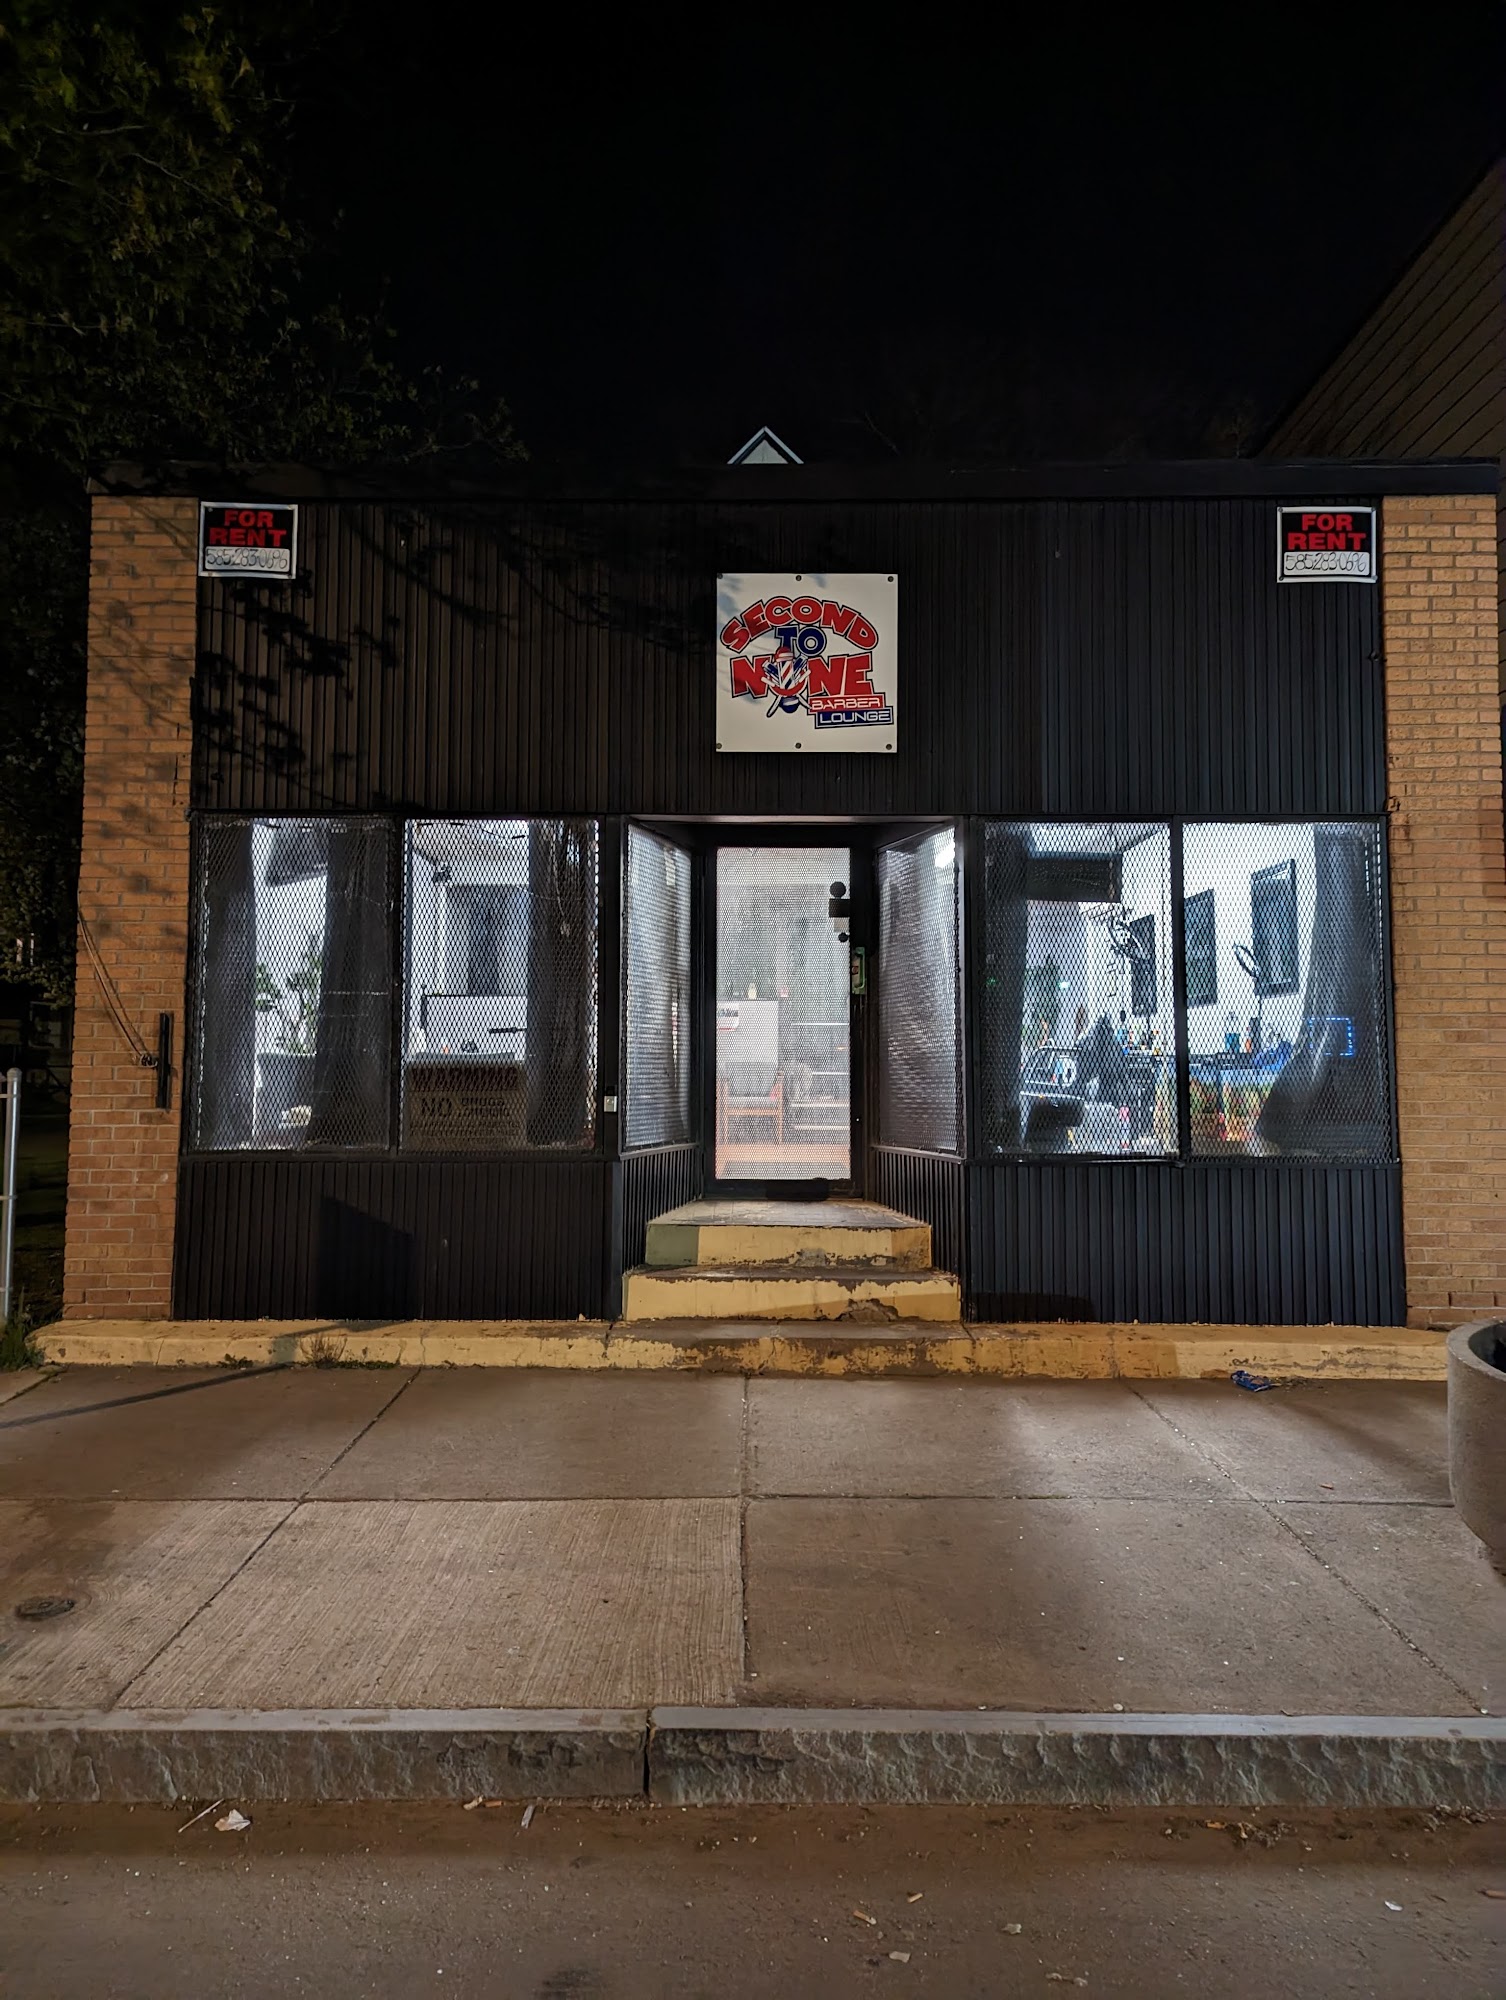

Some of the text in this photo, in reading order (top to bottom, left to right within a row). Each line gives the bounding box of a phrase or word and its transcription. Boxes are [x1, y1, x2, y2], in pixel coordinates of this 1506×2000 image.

[224, 510, 274, 528] FOR
[1301, 514, 1353, 531] FOR
[209, 527, 287, 547] RENT
[1287, 532, 1366, 550] RENT
[720, 596, 878, 653] SECOND
[775, 625, 827, 656] TO
[730, 651, 874, 698] NONE
[811, 697, 881, 710] BARBER
[819, 711, 891, 723] LOUNGE
[421, 1097, 453, 1118] NO
